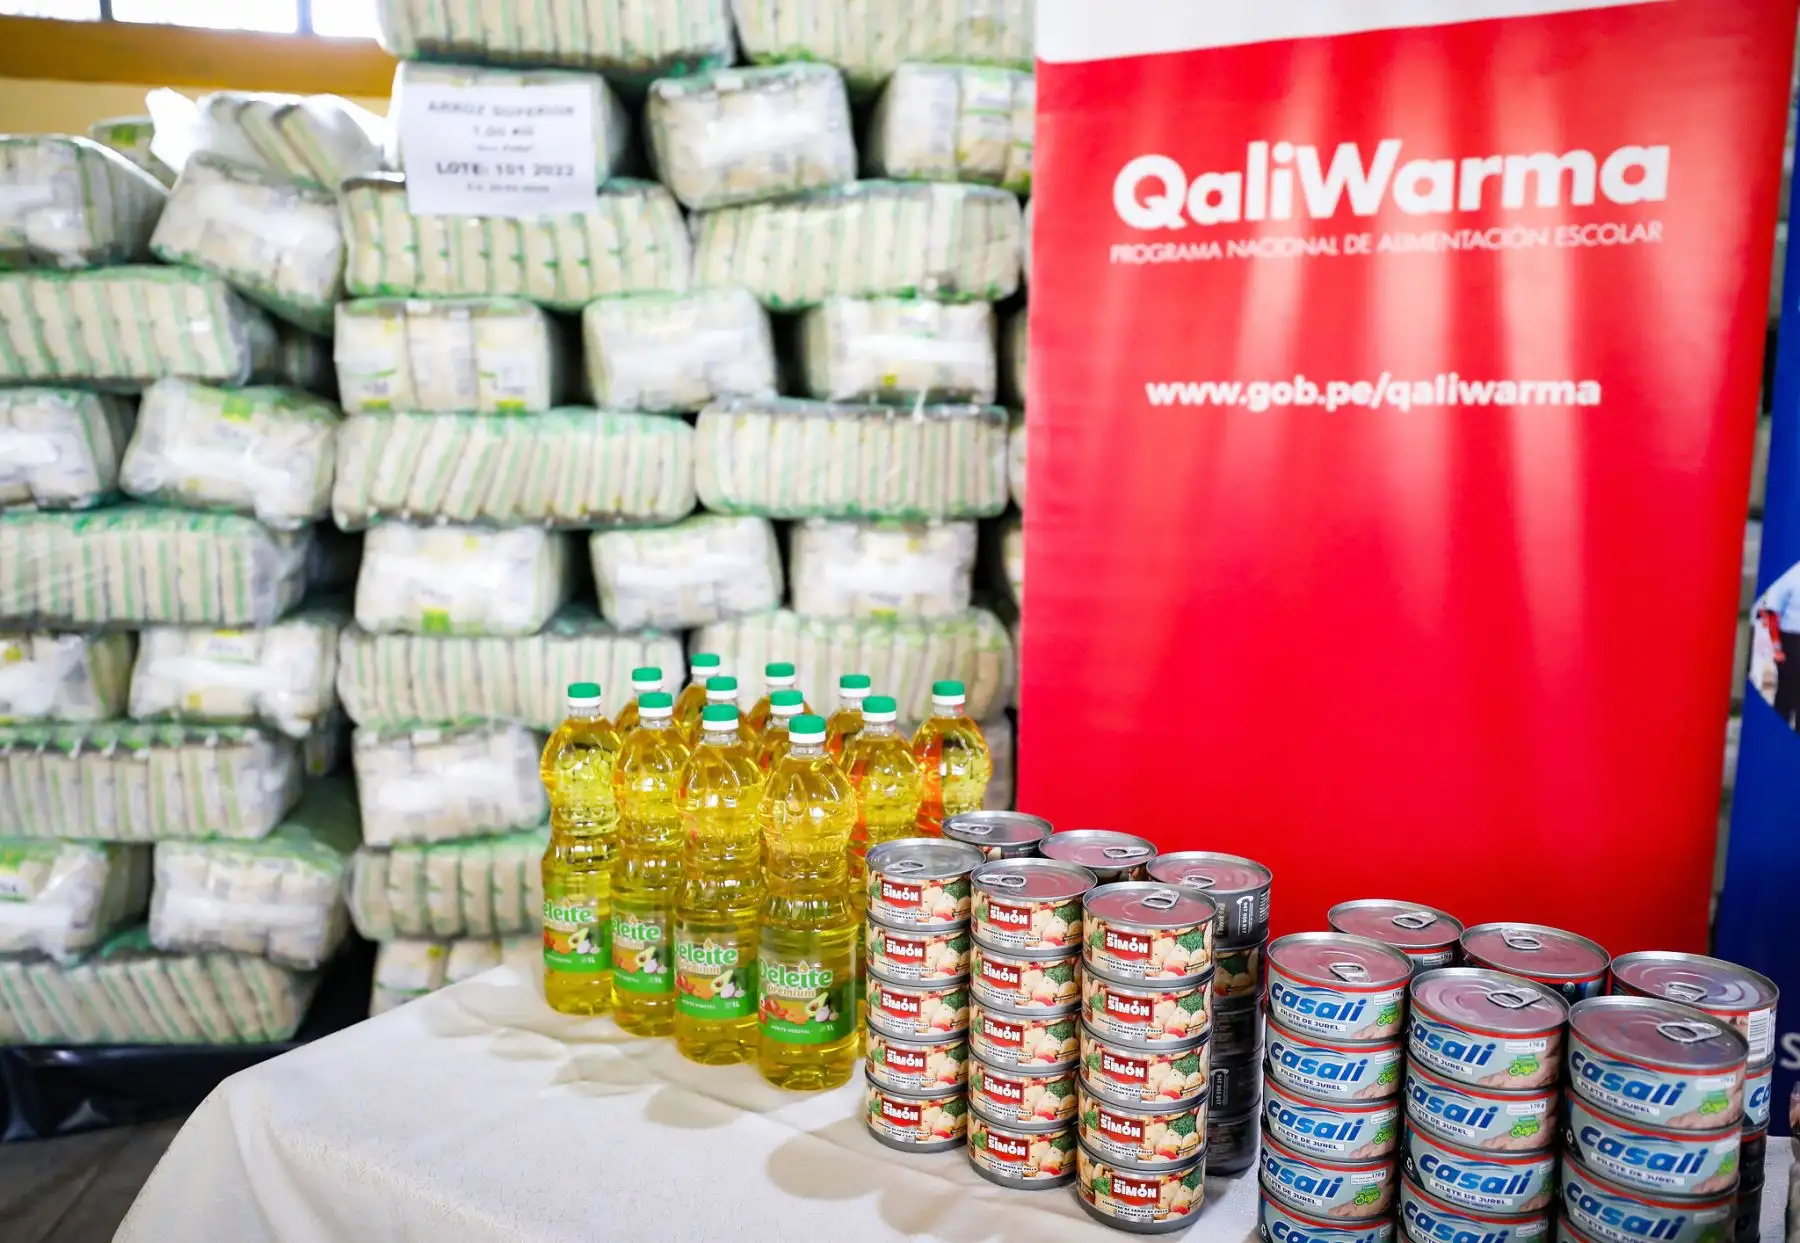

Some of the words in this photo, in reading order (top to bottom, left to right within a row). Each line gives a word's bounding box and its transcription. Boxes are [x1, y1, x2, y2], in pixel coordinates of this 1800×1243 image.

[436, 162, 488, 176] LOTE:
[1113, 139, 1669, 230] QaliWarma
[1110, 241, 1222, 264] PROGRAMA
[1226, 234, 1339, 259] NACIONAL
[1344, 233, 1371, 255] DE
[1376, 223, 1547, 252] ALIMENTACIÓN
[1554, 220, 1663, 247] ESCOLAR
[1146, 373, 1601, 411] www.gob.pe/qaliwarma
[544, 901, 592, 922] eleite
[612, 917, 661, 940] eleite
[677, 943, 737, 965] eleite
[1280, 1008, 1300, 1022] FILETE
[1280, 1068, 1302, 1081] FILETE
[1278, 1126, 1298, 1140] FILETE
[1113, 1182, 1157, 1198] SIMÓN
[1434, 1182, 1461, 1196] FILETE
[1293, 1192, 1317, 1204] JUREL
